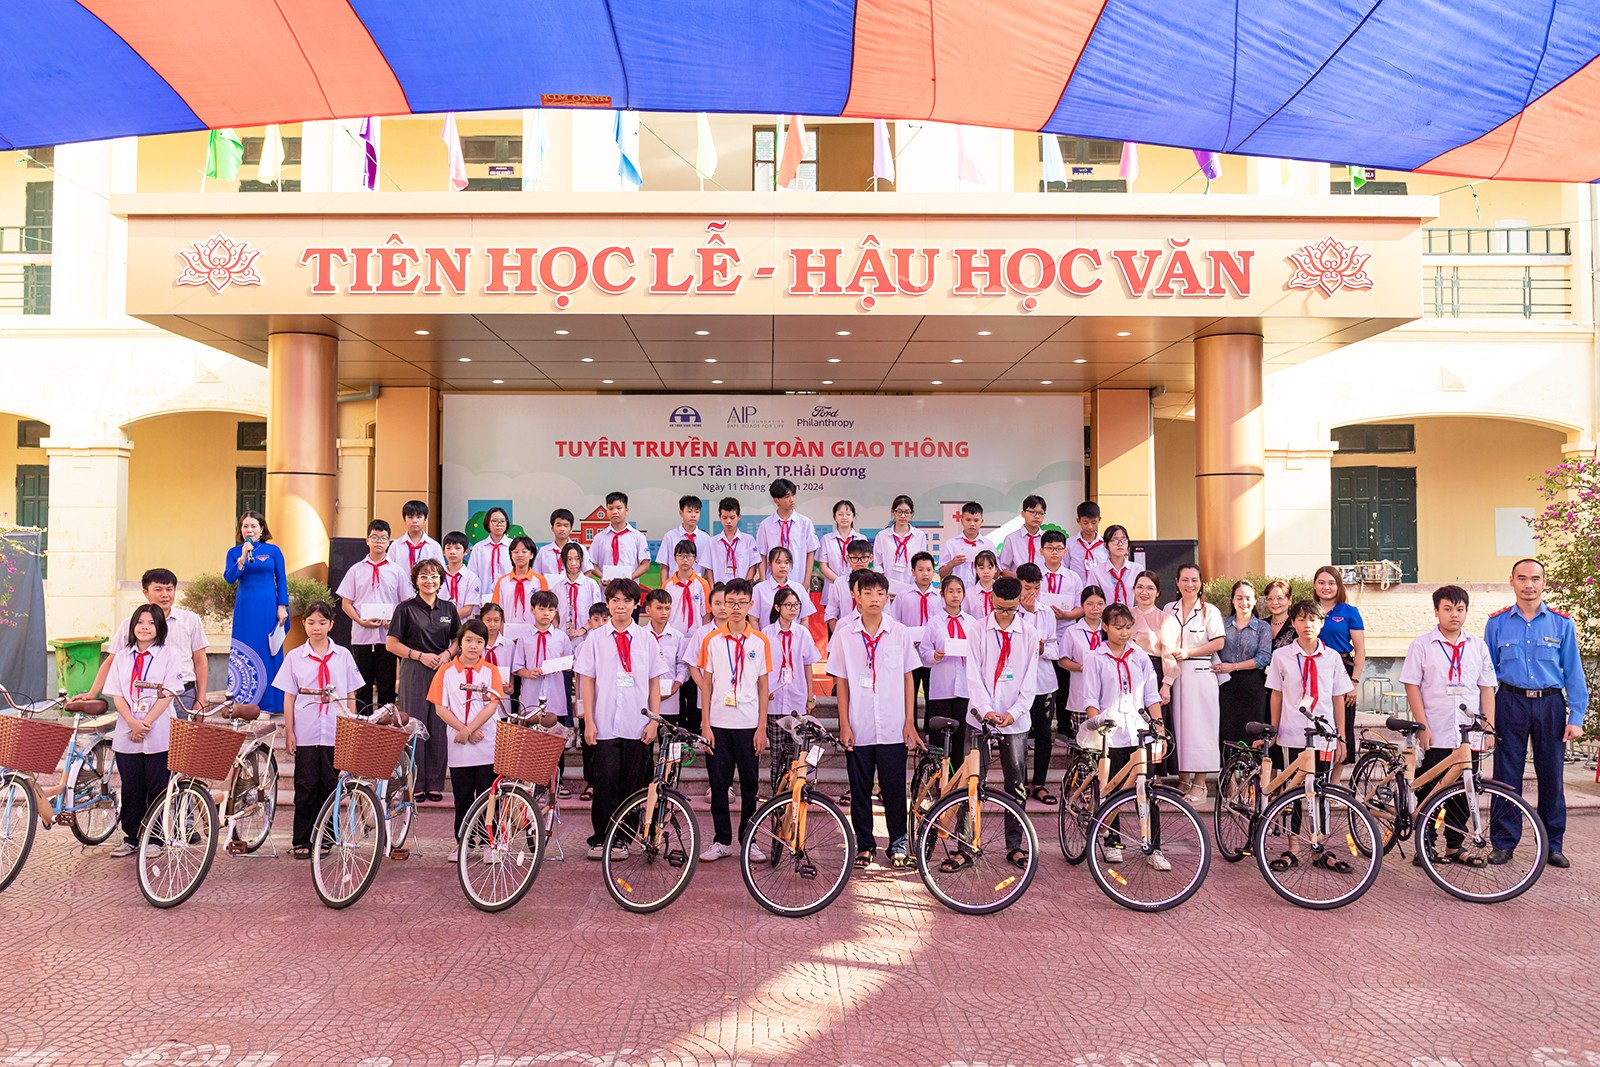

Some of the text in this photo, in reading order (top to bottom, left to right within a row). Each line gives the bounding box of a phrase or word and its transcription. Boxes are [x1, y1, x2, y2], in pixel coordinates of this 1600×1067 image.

[300, 221, 1256, 311] TIÊN HỌC LỄ - HẬU HỌC VĂN
[727, 406, 757, 423] AIP
[811, 405, 839, 418] Ford
[797, 418, 854, 429] Philanthropy
[555, 435, 970, 458] TUYÊN TRUYỀN AN TOÀN GIAO THÔNG
[670, 464, 867, 479] THCS Tân Bình, TP.Hải Dương
[703, 482, 725, 492] Ngày
[727, 483, 737, 491] 11
[740, 482, 766, 492] tháng
[803, 482, 824, 491] 2024
